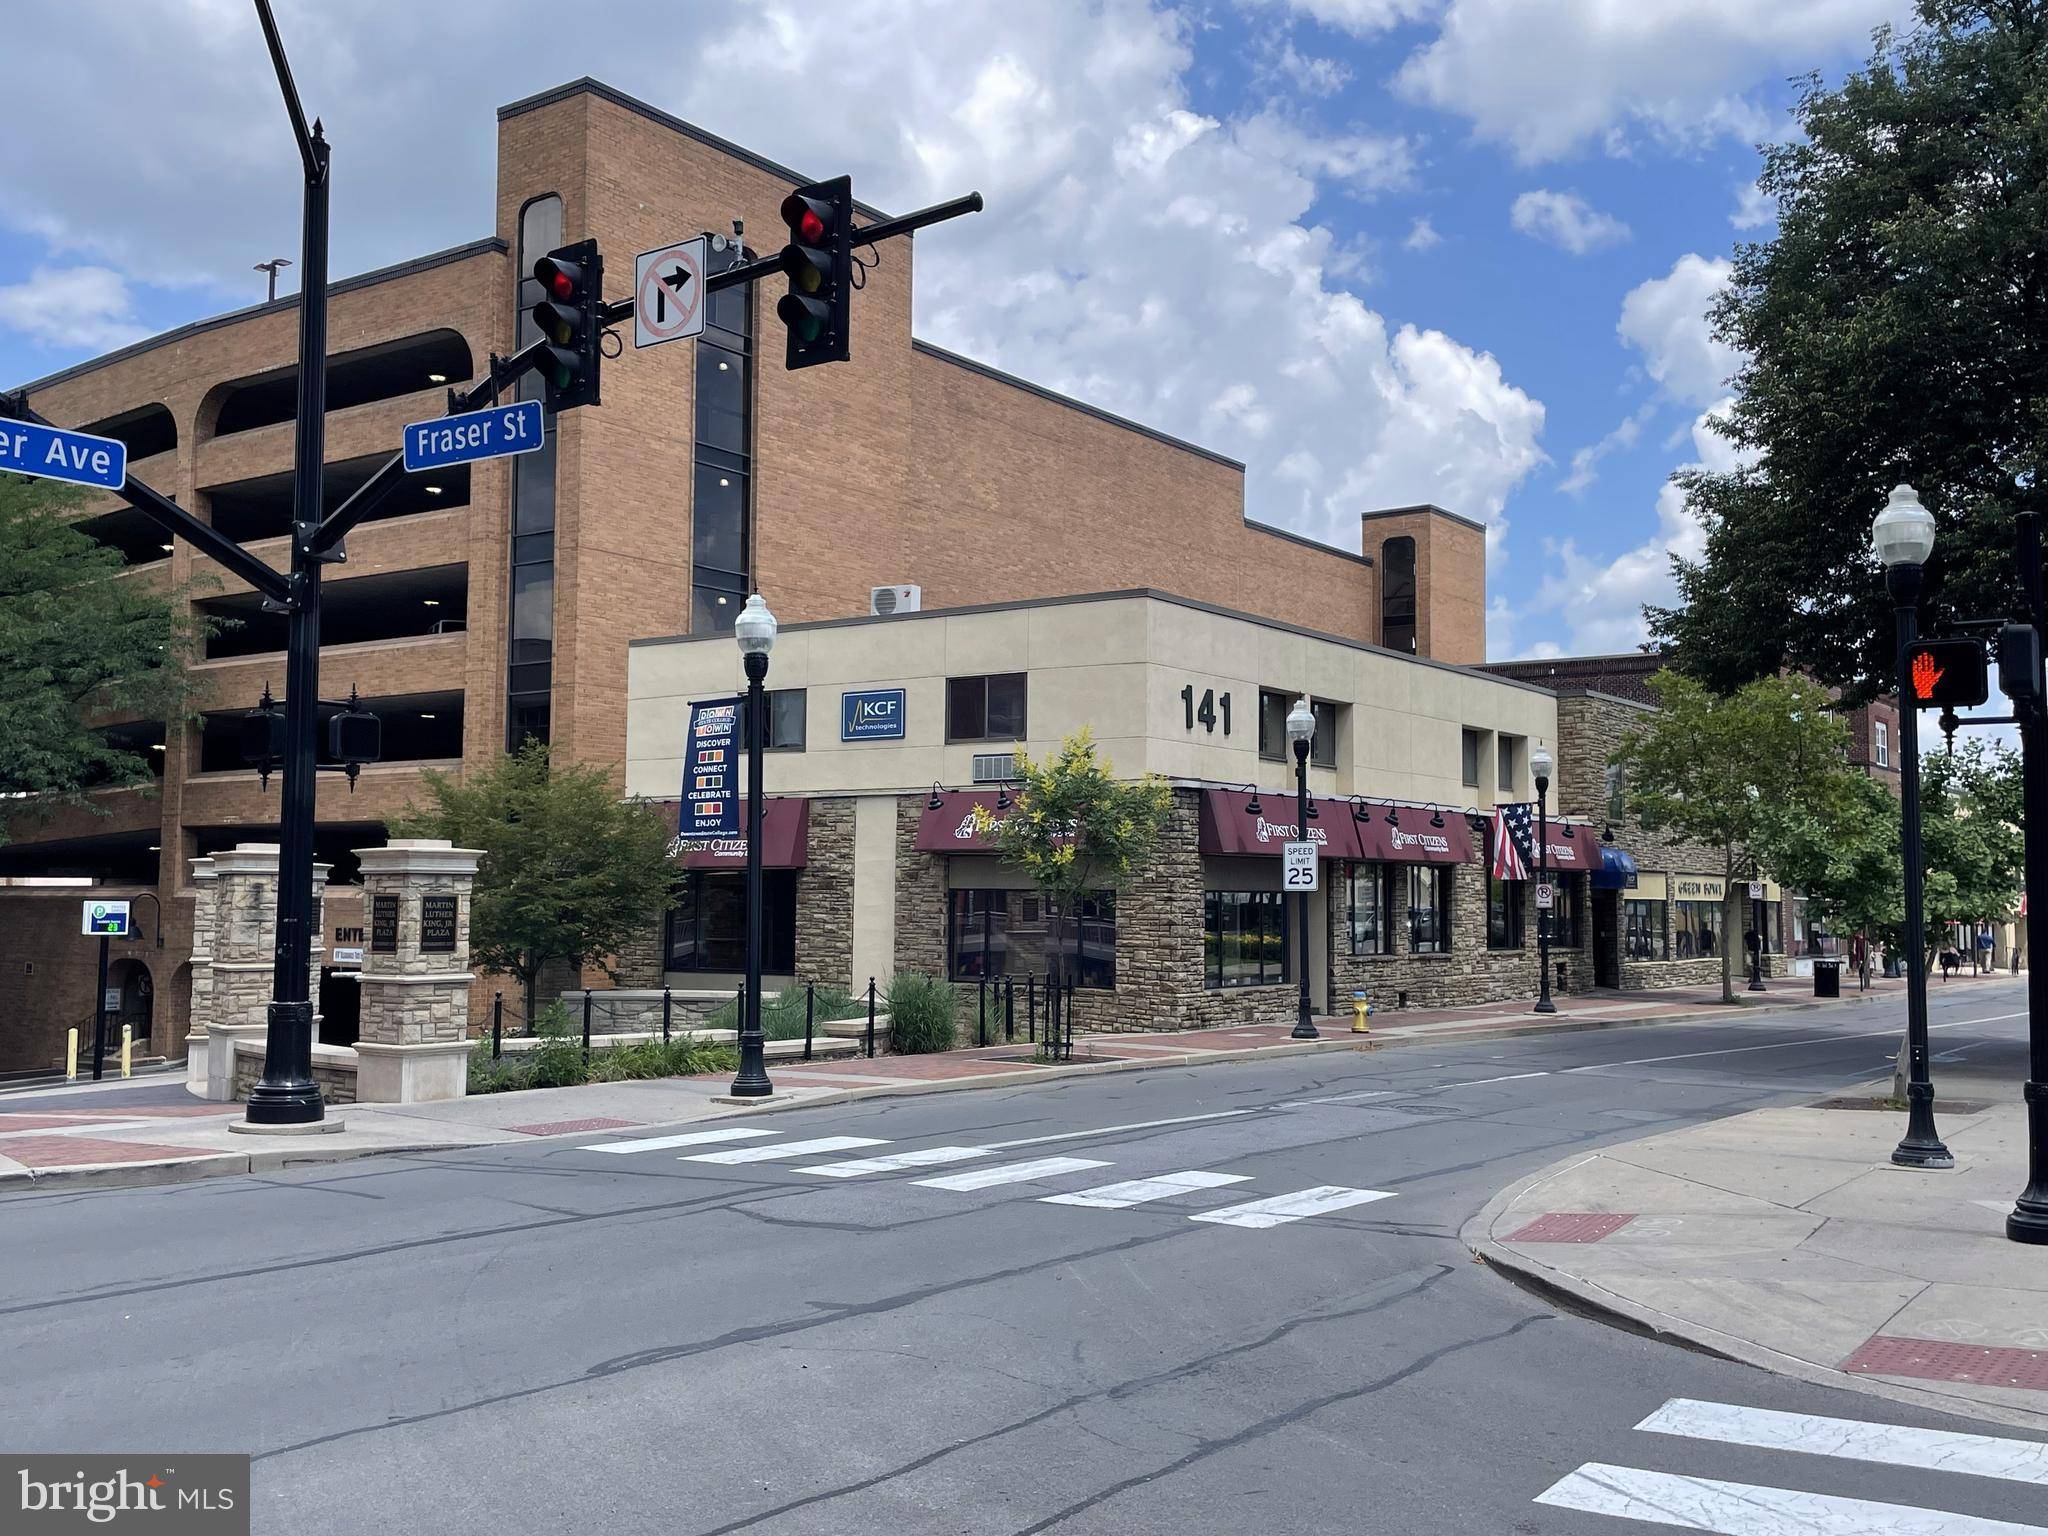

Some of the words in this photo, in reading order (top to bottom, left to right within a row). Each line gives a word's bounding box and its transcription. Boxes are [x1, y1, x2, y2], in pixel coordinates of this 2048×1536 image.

[418, 420, 492, 457] Fraser
[503, 410, 527, 441] St
[45, 437, 110, 474] Ave
[700, 708, 732, 720] DOWN
[864, 701, 897, 716] KCF
[1181, 684, 1231, 735] 141
[696, 723, 730, 736] TOWN
[855, 723, 897, 731] technologies
[696, 739, 731, 748] DISCOVER
[693, 765, 727, 774] CONNECT
[688, 790, 732, 799] CELEBRATE
[695, 819, 721, 827] ENJOY
[1266, 823, 1289, 837] FIRST
[711, 838, 748, 851] CITIZE
[1399, 832, 1417, 845] FIRST
[1418, 833, 1448, 847] CITIZENS
[1287, 847, 1314, 856] SPEED
[1290, 857, 1311, 865] LIMIT
[1288, 868, 1313, 885] 25
[1678, 881, 1701, 896] GREEN
[425, 901, 454, 909] MARTIN
